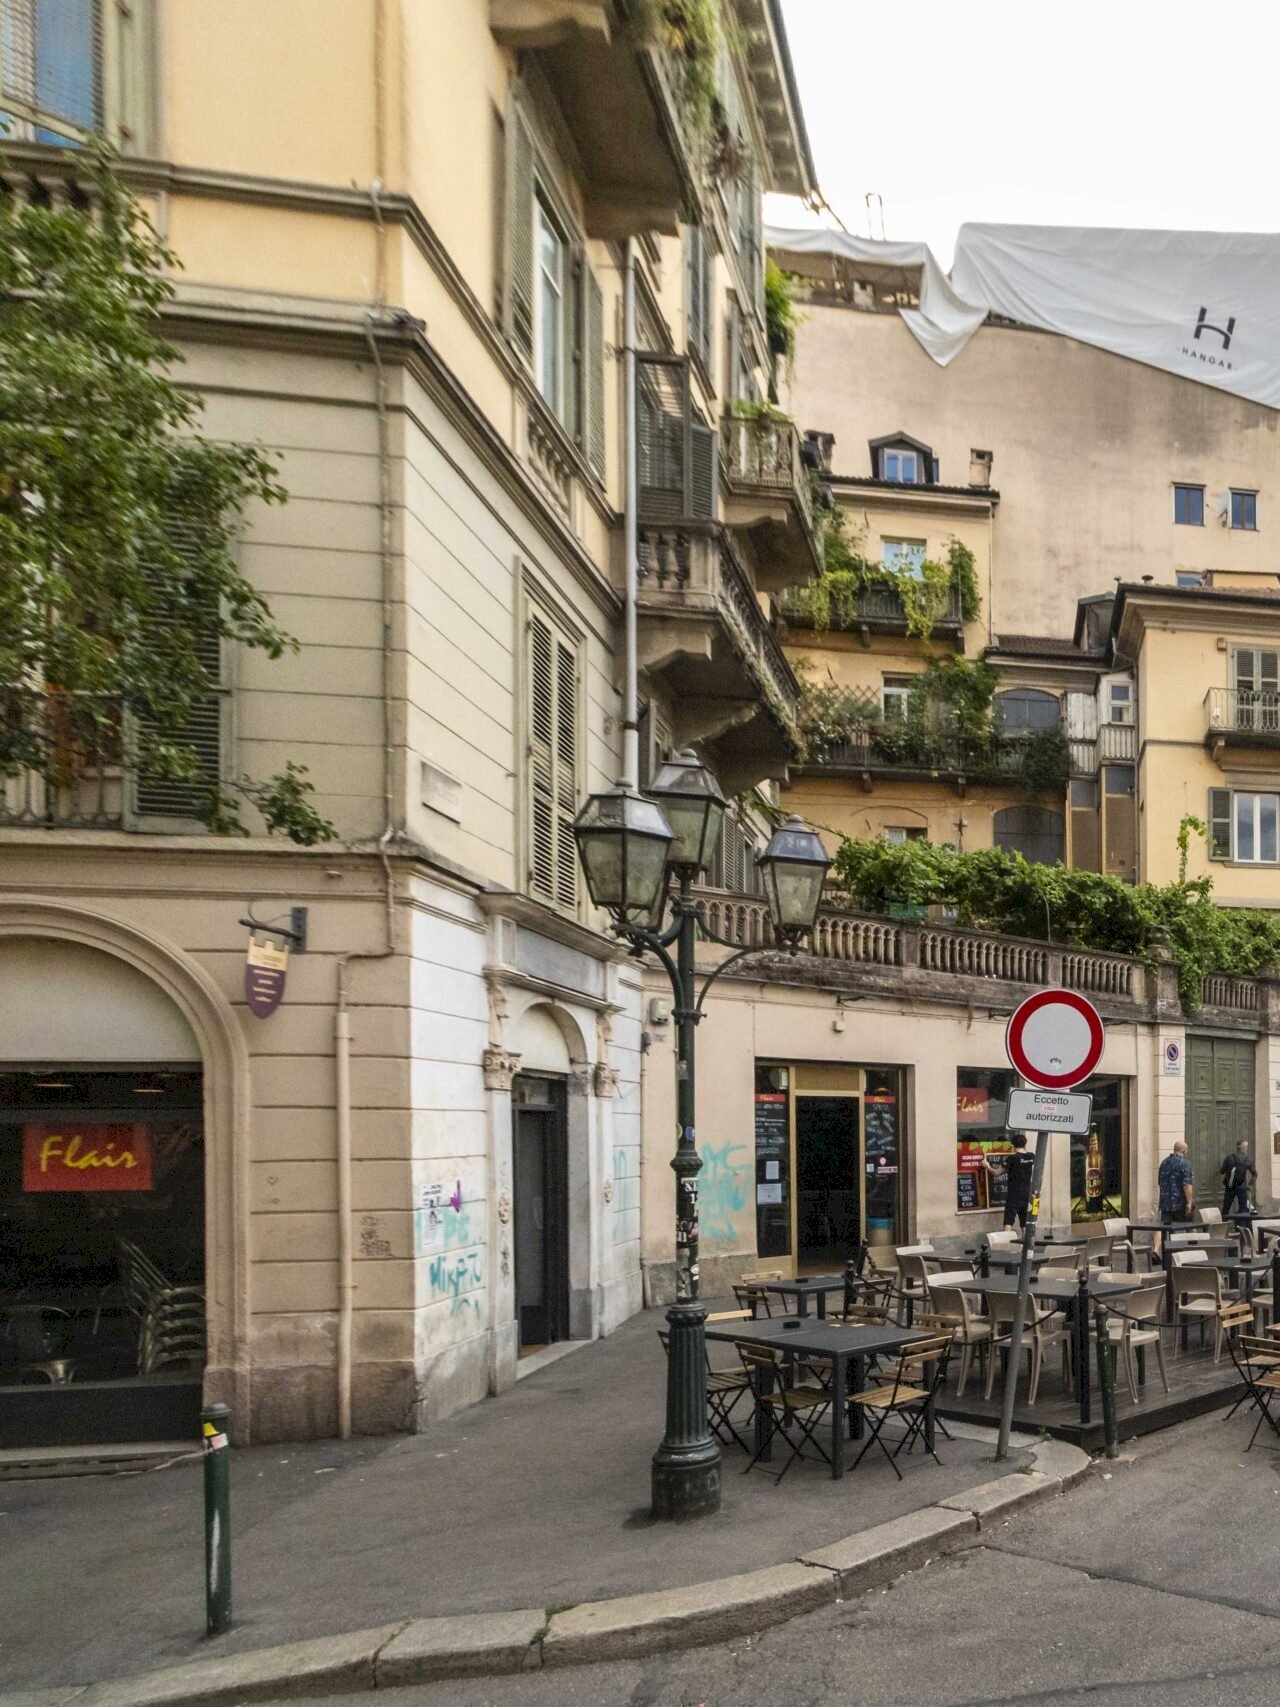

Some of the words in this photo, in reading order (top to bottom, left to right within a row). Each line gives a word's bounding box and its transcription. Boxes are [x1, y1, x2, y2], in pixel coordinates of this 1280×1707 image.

[1181, 346, 1233, 371] HANGAR
[1034, 1094, 1069, 1105] Eccetto
[1026, 1111, 1074, 1123] autorizzati
[39, 1134, 137, 1173] Flair
